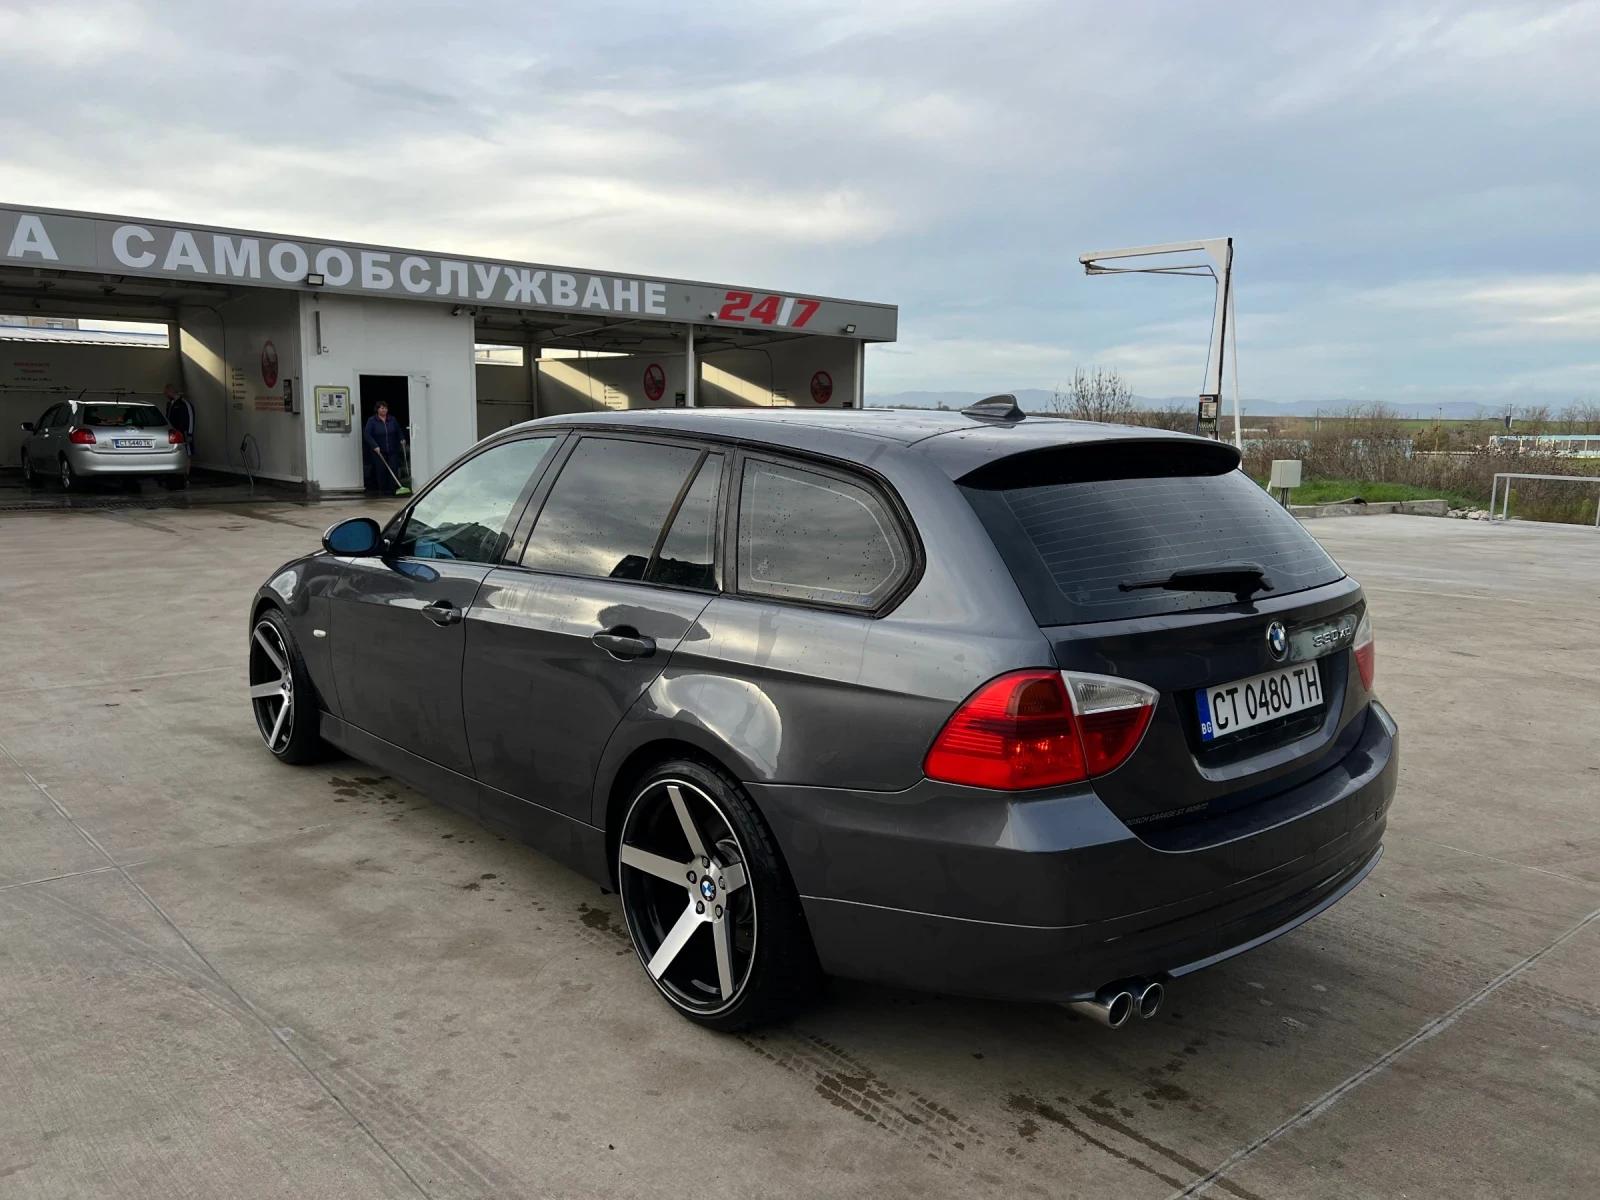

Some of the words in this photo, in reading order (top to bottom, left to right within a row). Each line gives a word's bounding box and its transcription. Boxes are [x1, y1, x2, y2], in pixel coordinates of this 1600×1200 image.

[112, 225, 666, 315] САМООБСЛУЖВАНЕ
[718, 291, 821, 328] 24/7
[1212, 687, 1239, 730] CT
[1245, 674, 1292, 720] 0480
[1293, 665, 1320, 705] TH
[1201, 721, 1213, 735] BG
[1149, 809, 1177, 822] GARAGE
[1185, 802, 1209, 814] MORITZ
